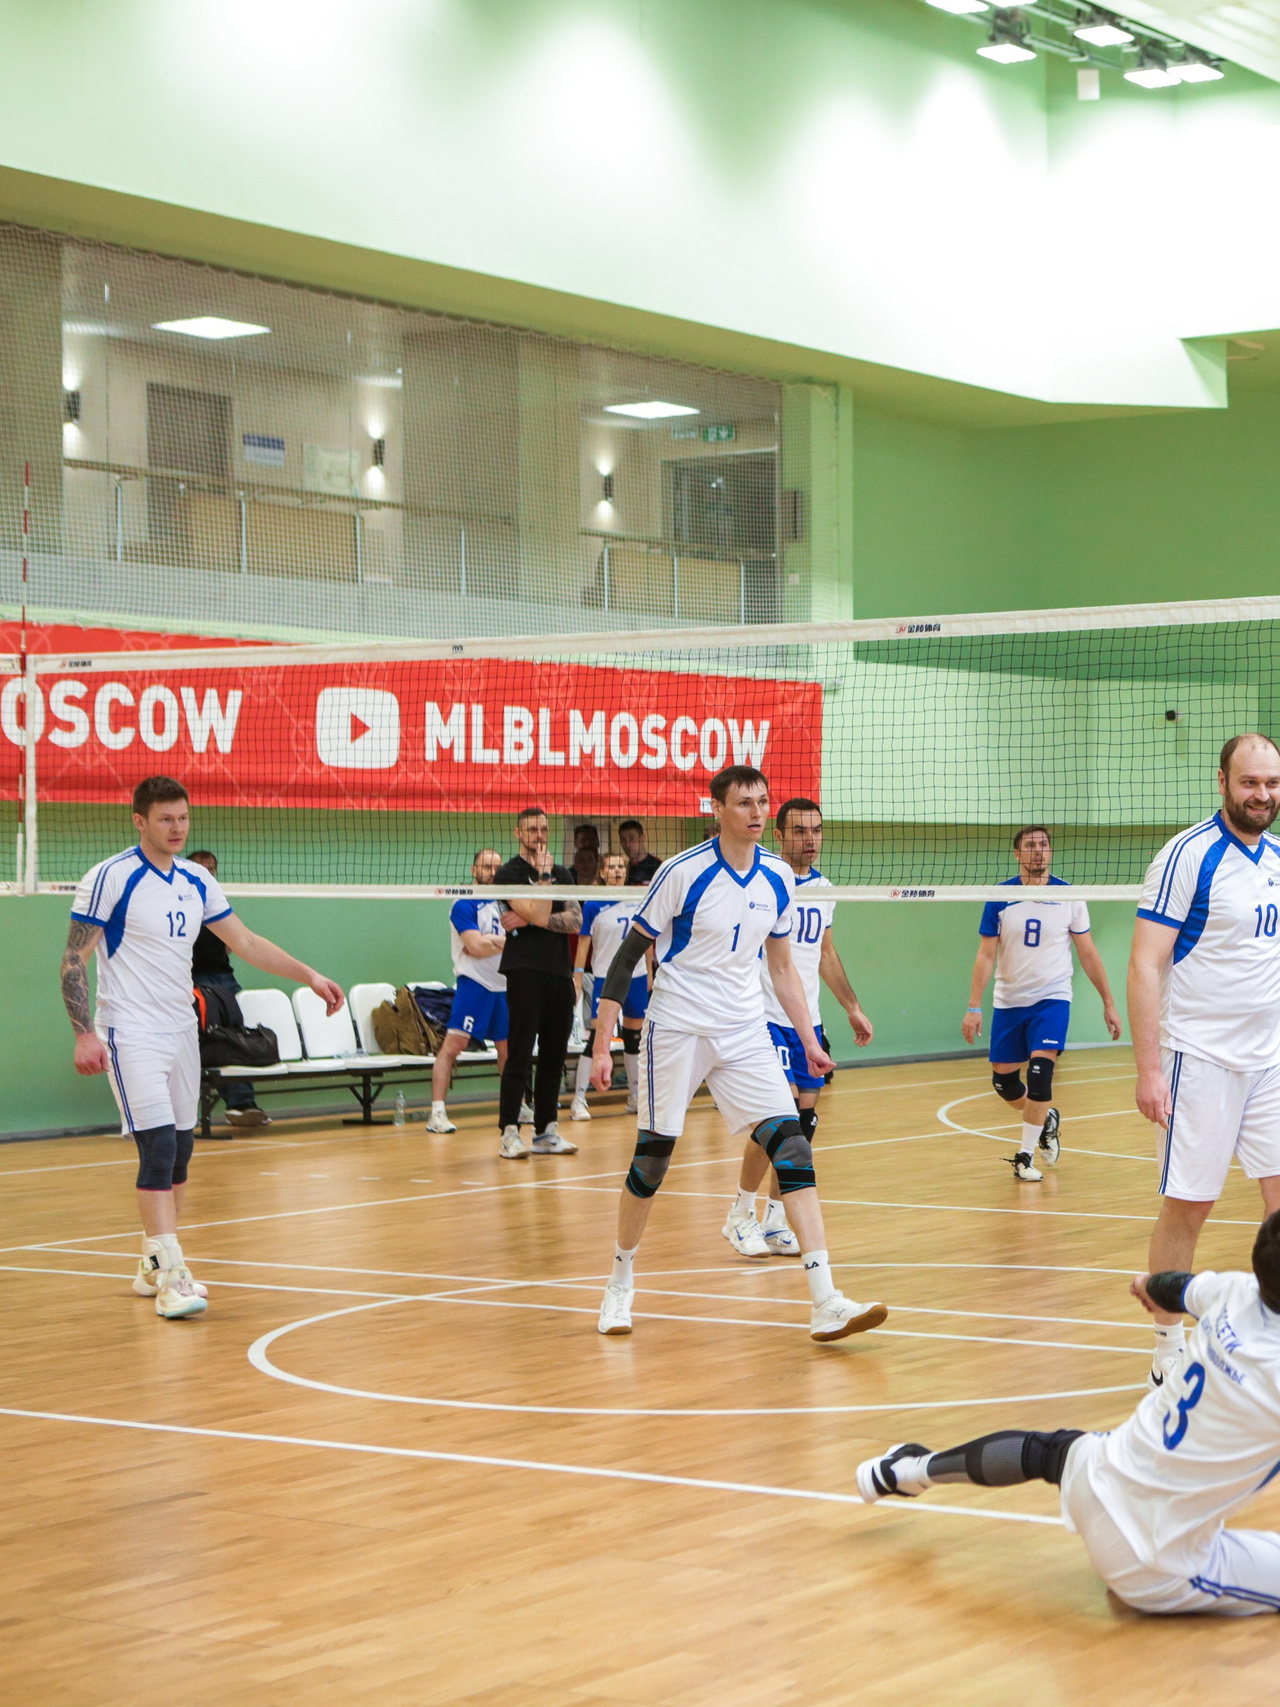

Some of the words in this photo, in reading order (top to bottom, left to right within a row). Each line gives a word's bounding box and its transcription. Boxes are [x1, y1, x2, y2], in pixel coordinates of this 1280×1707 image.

[424, 700, 770, 772] MLBLMOSCOW
[166, 911, 187, 938] 12
[617, 917, 629, 940] 7
[796, 906, 822, 944] 10
[1023, 918, 1042, 948] 8
[1254, 903, 1279, 938] 10
[731, 922, 741, 952] 1
[463, 1016, 475, 1033] 6
[1162, 1361, 1206, 1450] 3
